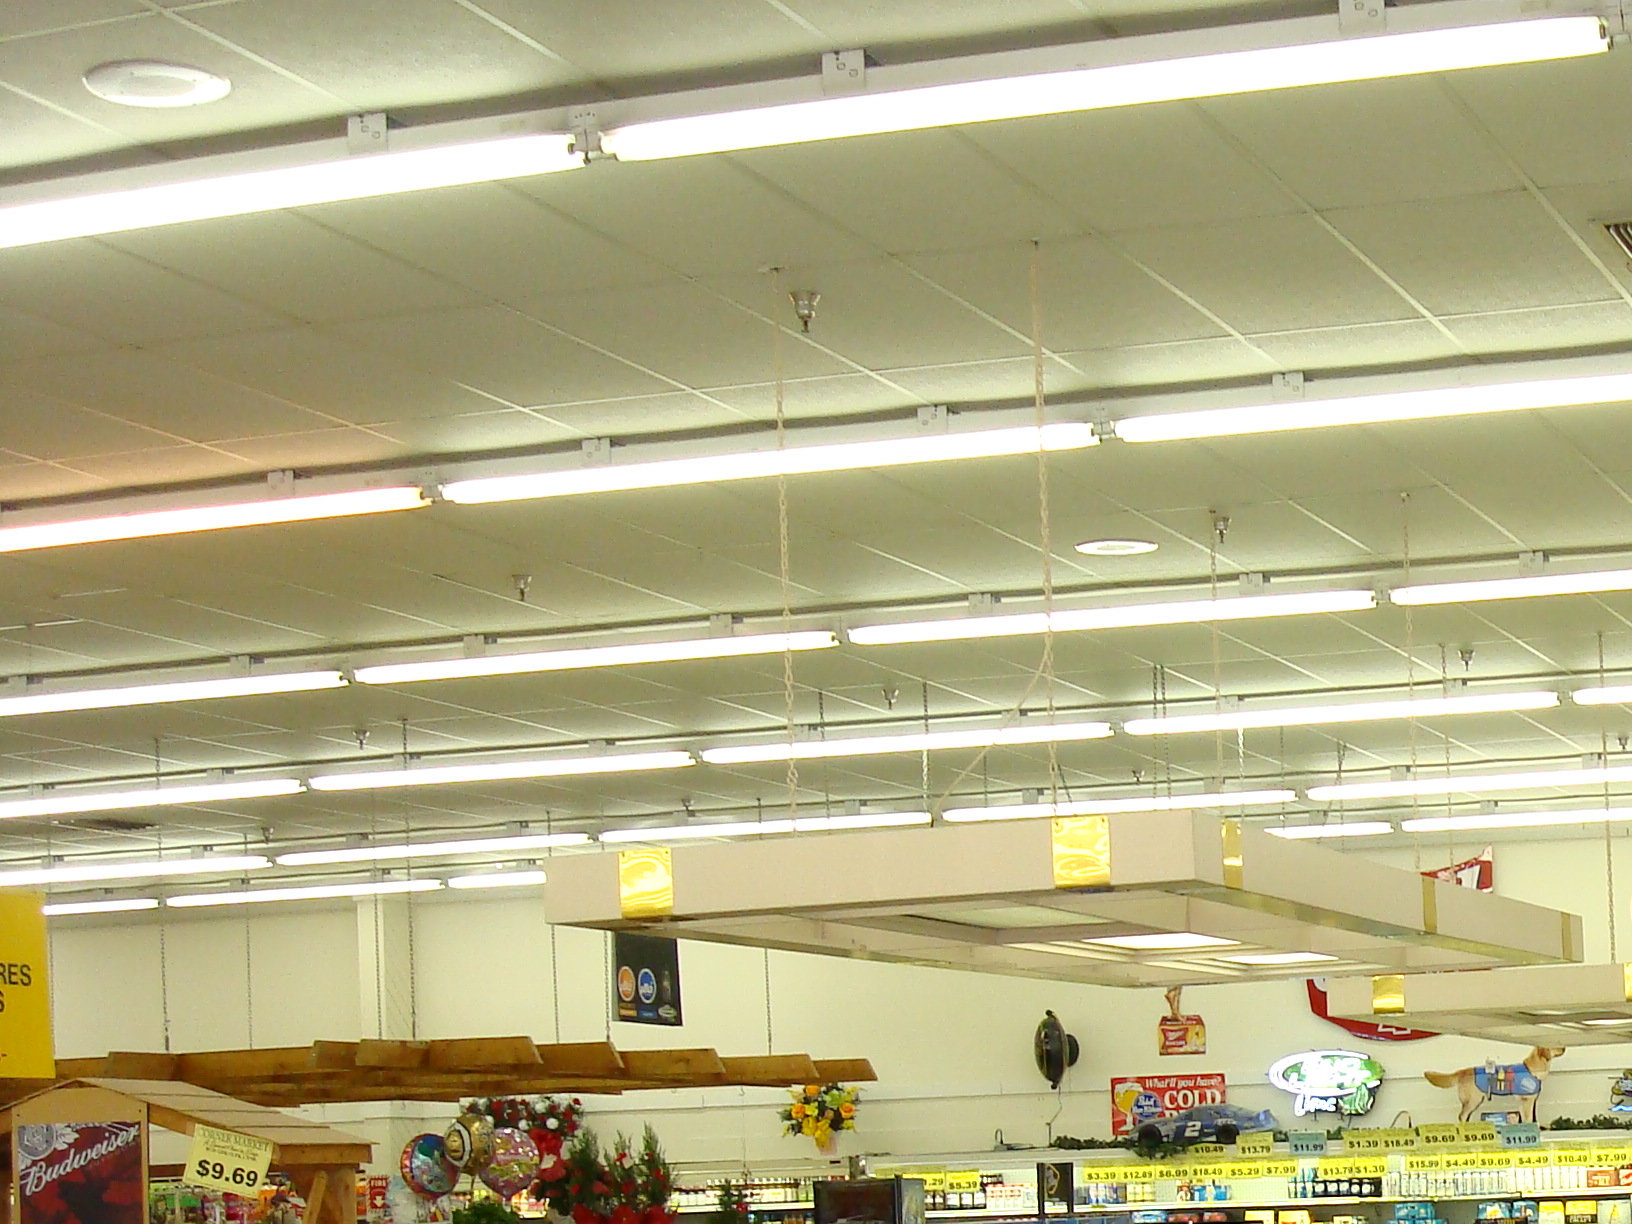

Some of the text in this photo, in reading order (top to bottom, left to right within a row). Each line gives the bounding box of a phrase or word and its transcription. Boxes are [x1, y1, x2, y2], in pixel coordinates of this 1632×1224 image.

[1178, 1079, 1196, 1090] you
[1197, 1076, 1222, 1087] have?
[1164, 1089, 1222, 1108] COLD
[1185, 1121, 1201, 1136] 2
[234, 1134, 270, 1151] MARKET
[20, 1124, 140, 1196] Budweiser
[196, 1159, 259, 1187] $9.69
